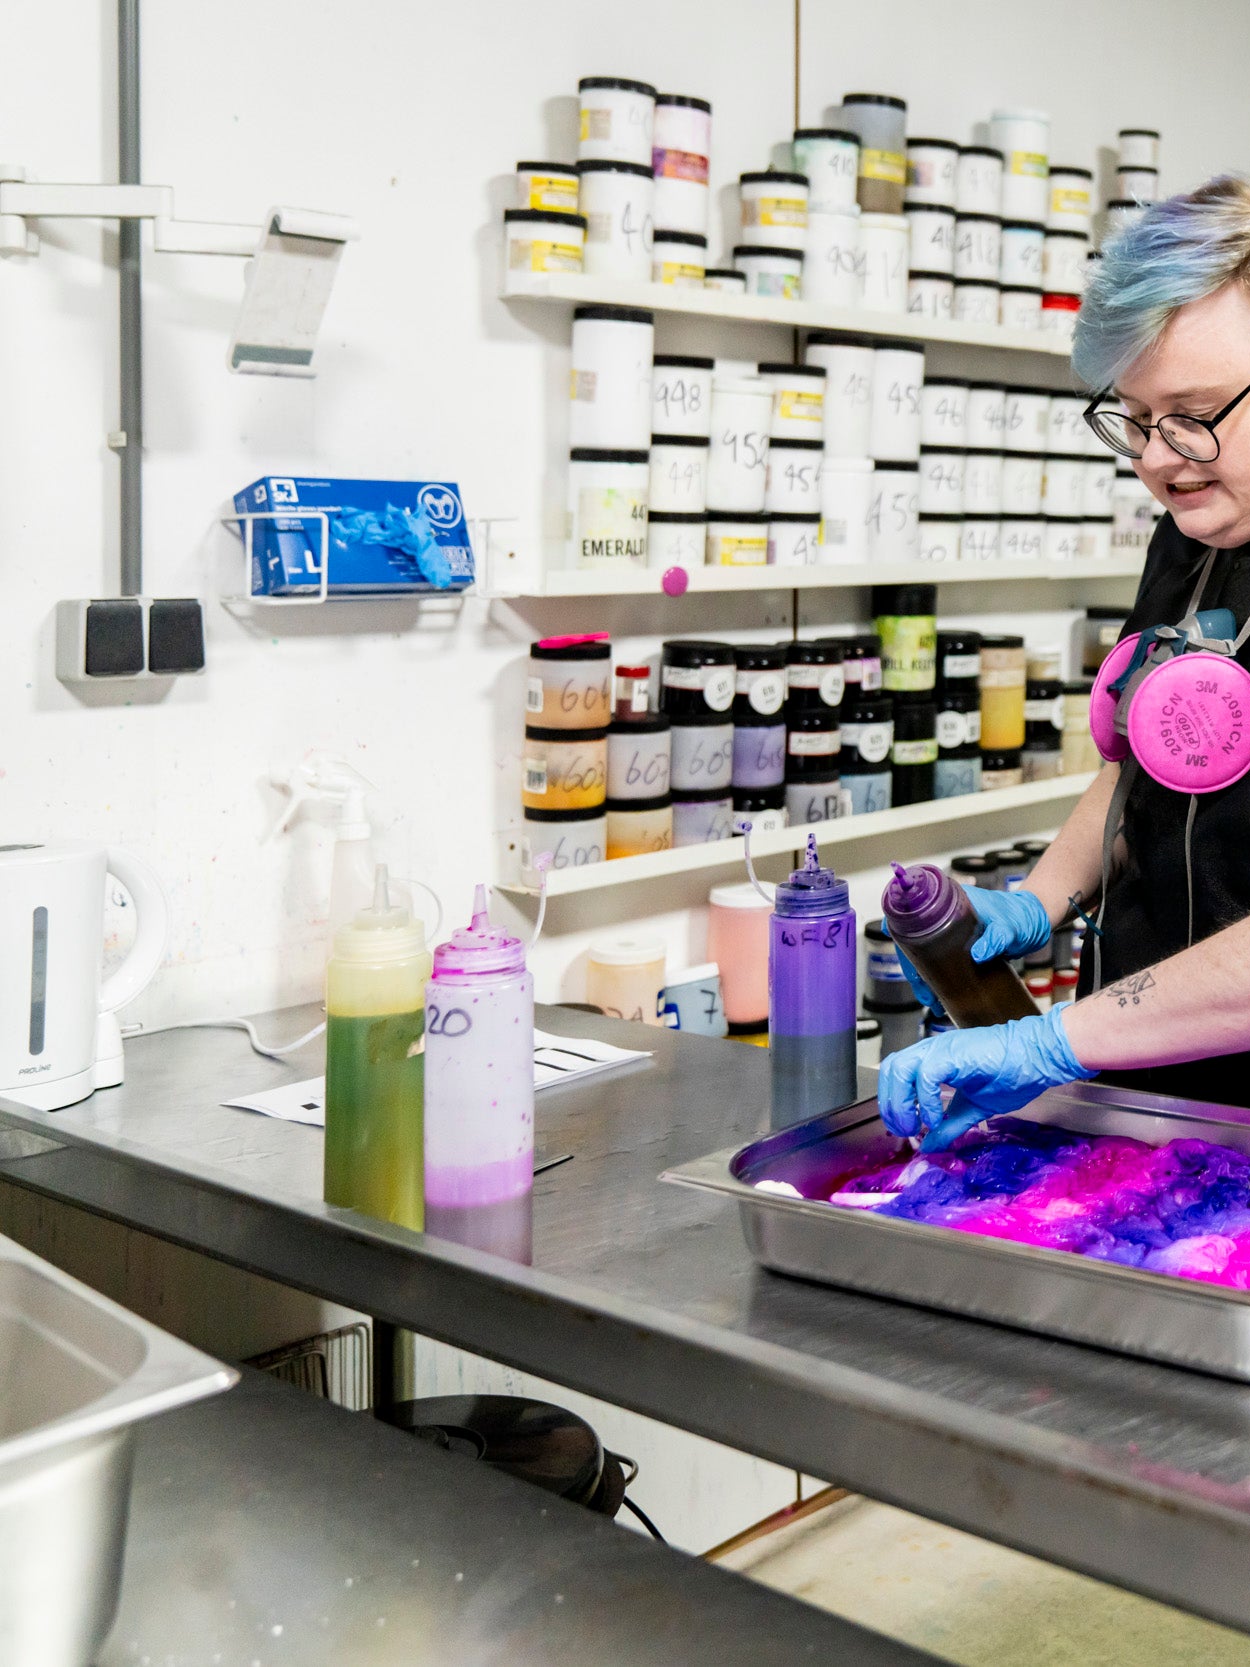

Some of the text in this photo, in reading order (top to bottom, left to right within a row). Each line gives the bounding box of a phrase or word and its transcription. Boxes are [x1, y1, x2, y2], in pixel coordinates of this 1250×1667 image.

[1177, 716, 1199, 746] P100
[1195, 680, 1219, 695] 3M
[1221, 691, 1244, 756] 2091CN
[427, 1004, 472, 1037] 20
[700, 989, 719, 1025] 7
